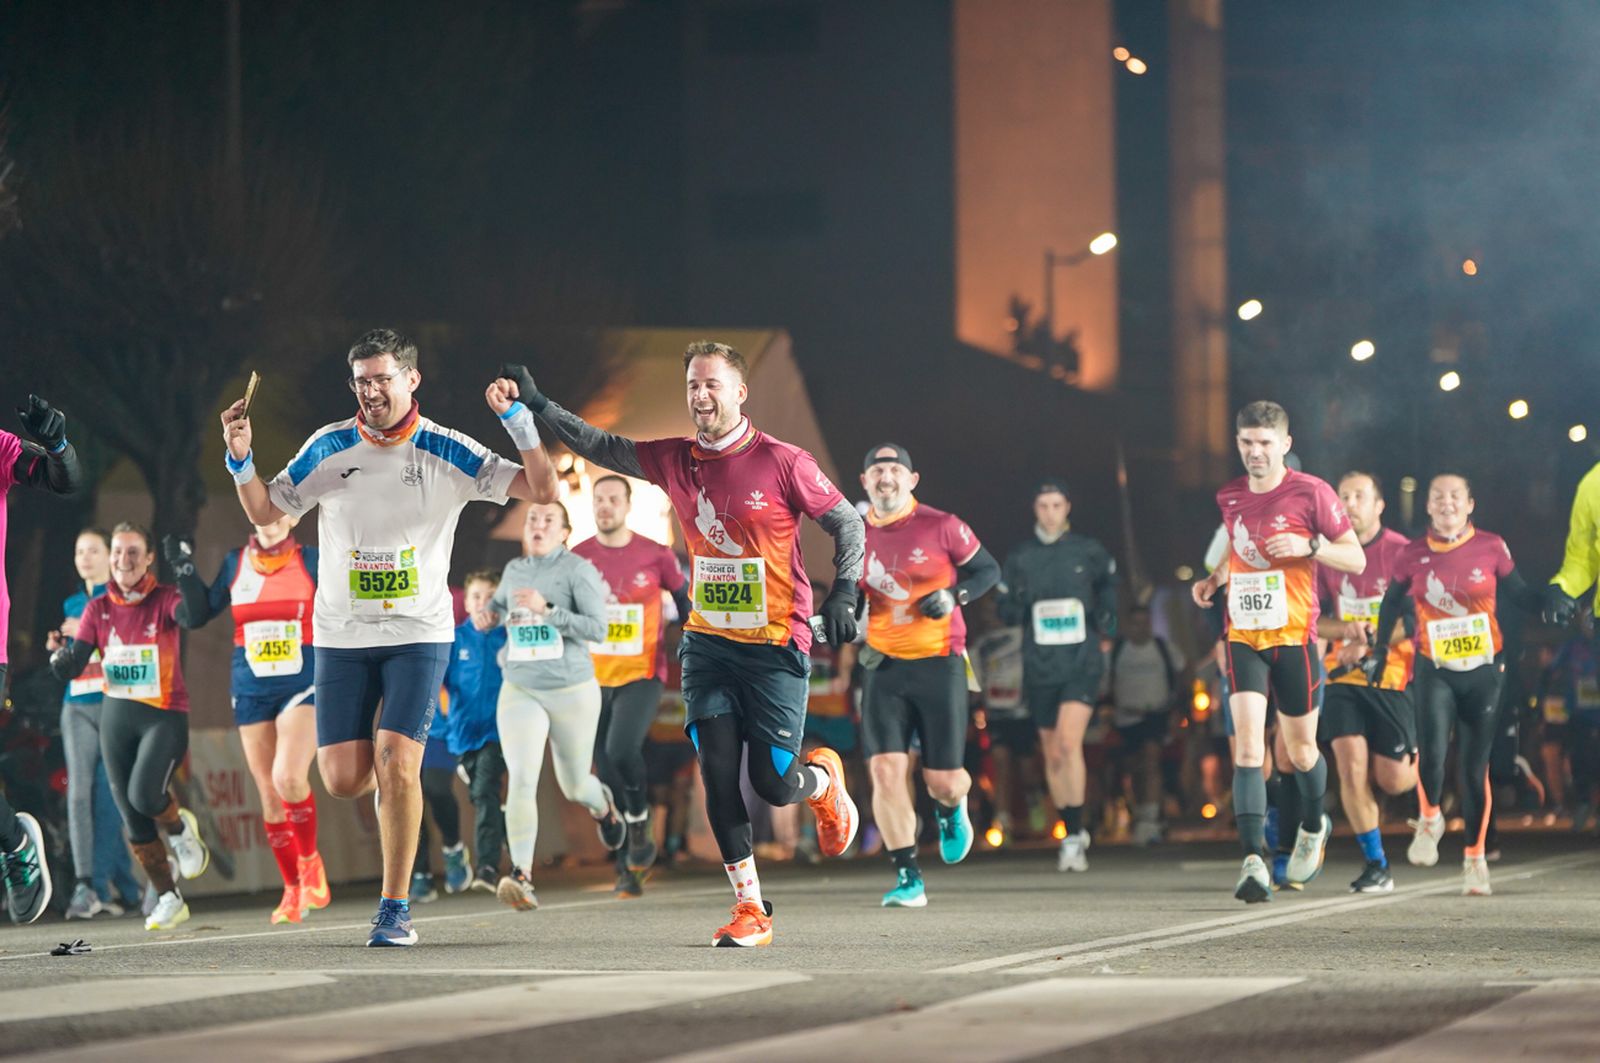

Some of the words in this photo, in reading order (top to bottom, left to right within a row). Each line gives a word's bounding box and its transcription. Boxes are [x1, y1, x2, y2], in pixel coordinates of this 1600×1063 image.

[708, 525, 725, 545] 43
[1243, 547, 1256, 561] 43
[354, 562, 368, 570] SAN
[727, 566, 735, 574] DE
[359, 570, 410, 592] 5523
[880, 580, 895, 593] 43
[704, 583, 752, 604] 5524
[1239, 594, 1272, 611] 1962
[518, 625, 549, 642] 9576
[1443, 635, 1482, 655] 2952
[113, 665, 147, 680] 8067
